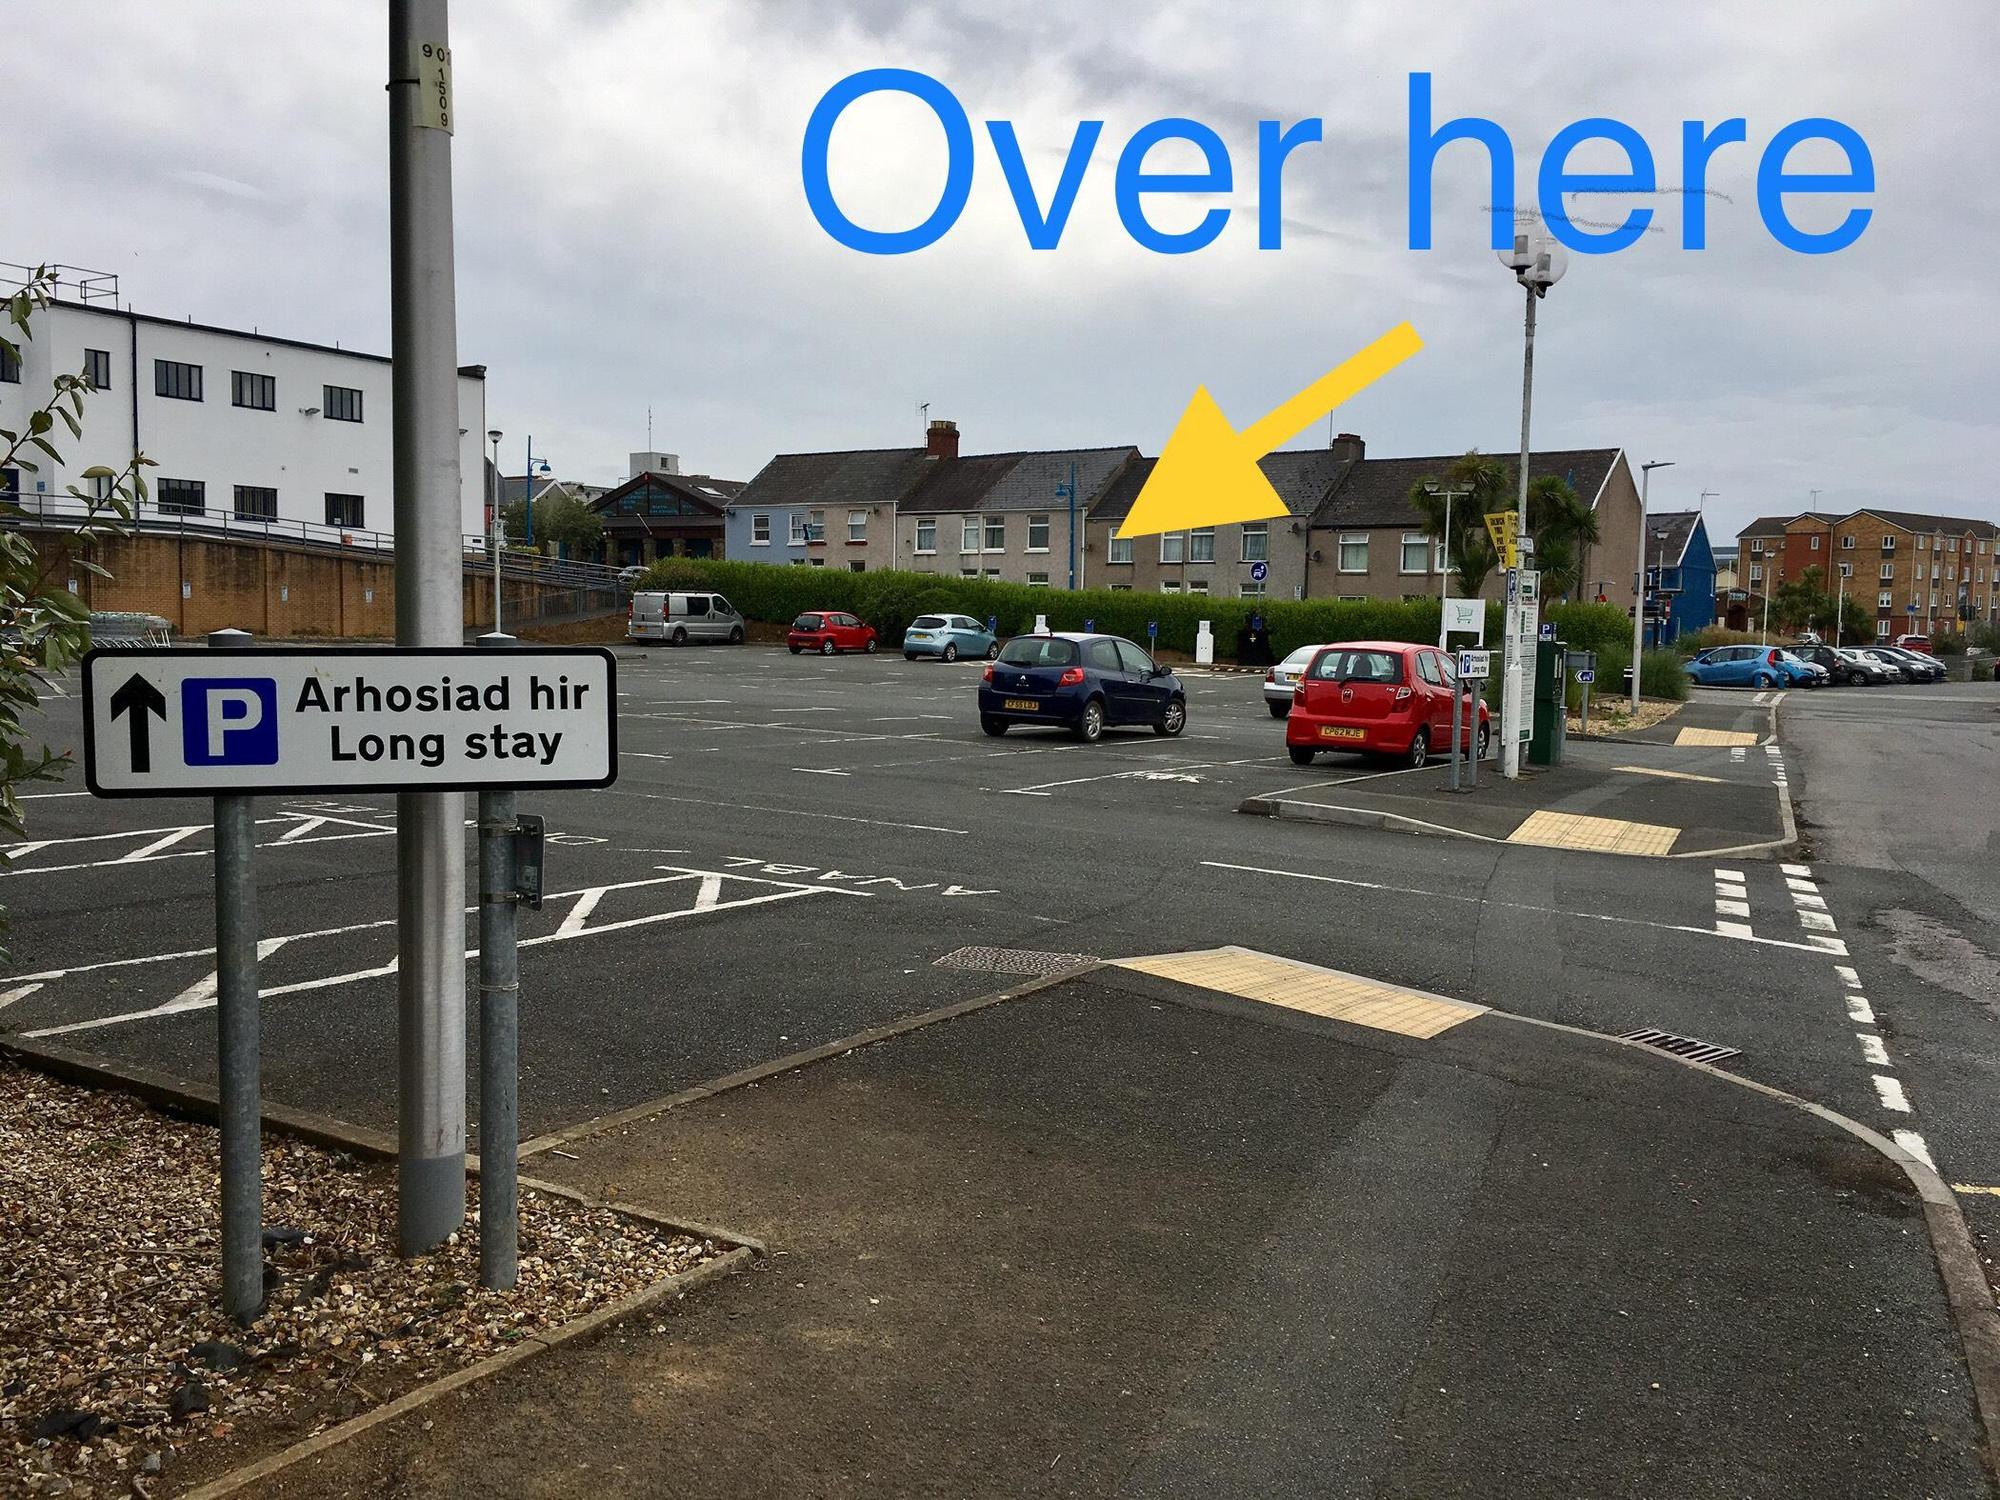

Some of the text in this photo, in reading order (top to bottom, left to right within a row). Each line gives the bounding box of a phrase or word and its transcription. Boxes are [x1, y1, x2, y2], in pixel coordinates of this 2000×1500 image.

[1542, 624, 1550, 634] P
[1464, 656, 1470, 672] P
[295, 675, 590, 713] Arhosiad hir
[206, 688, 263, 757] P
[331, 723, 563, 767] Long stay
